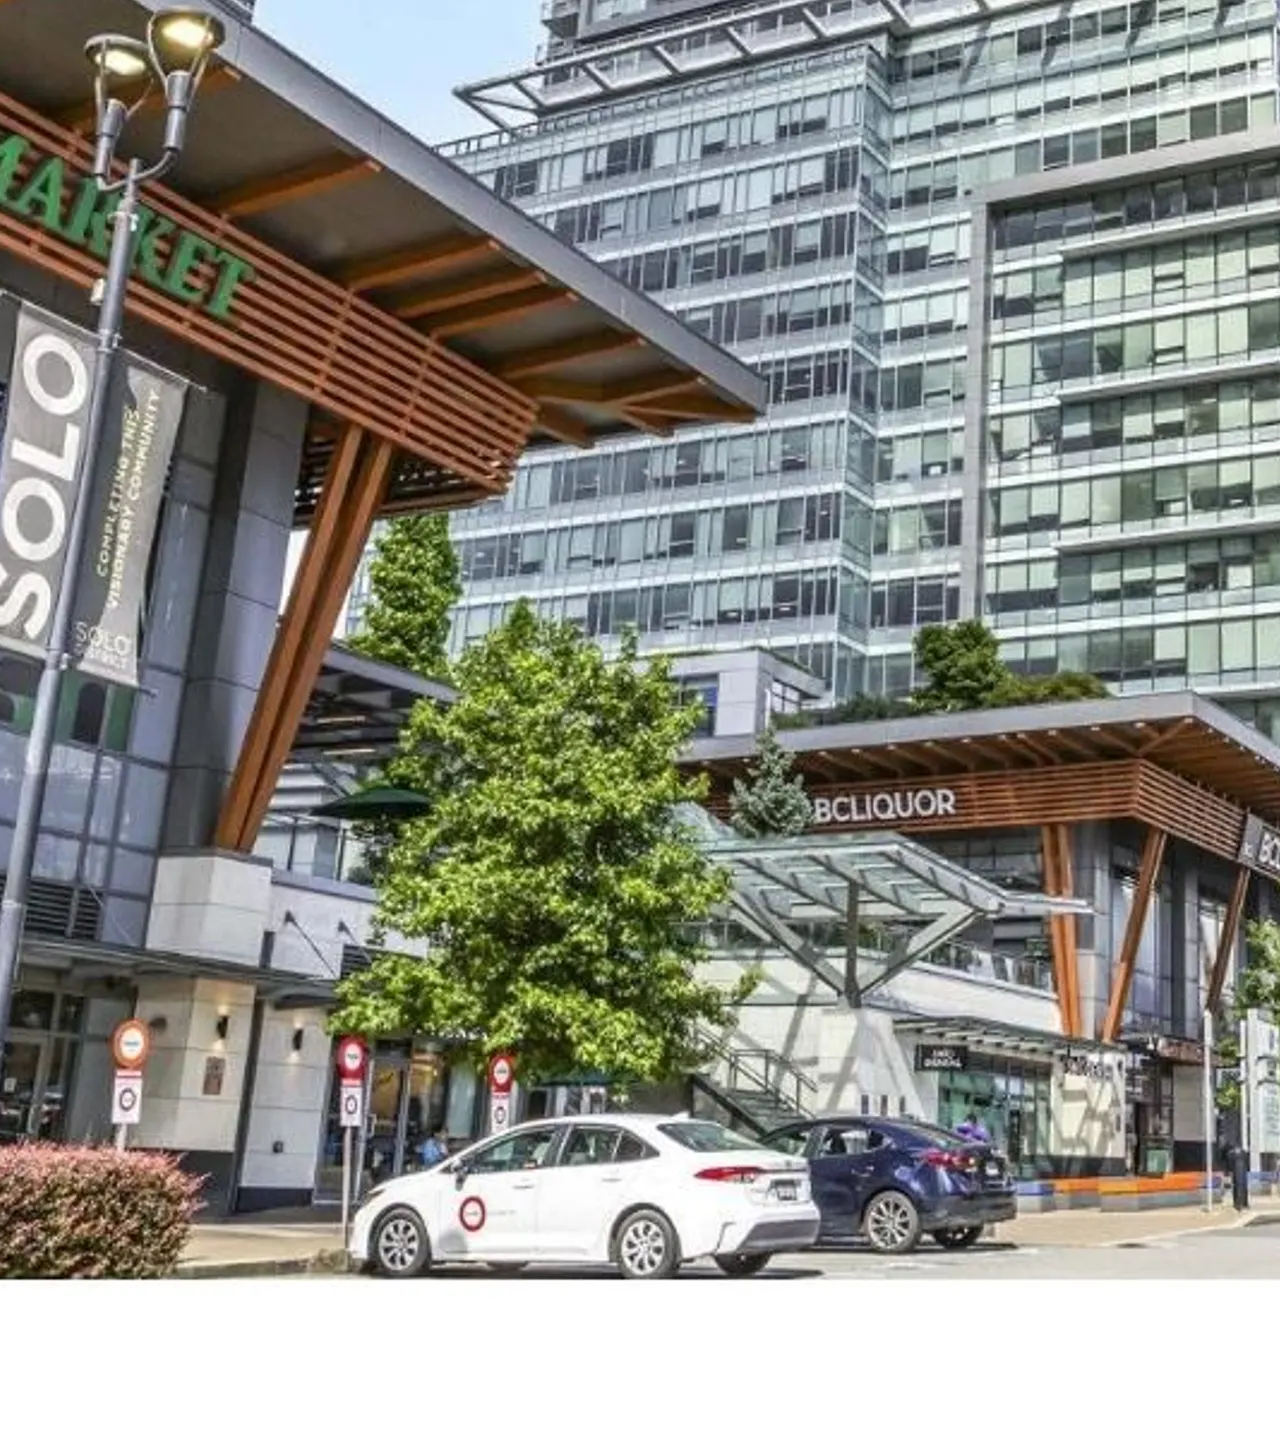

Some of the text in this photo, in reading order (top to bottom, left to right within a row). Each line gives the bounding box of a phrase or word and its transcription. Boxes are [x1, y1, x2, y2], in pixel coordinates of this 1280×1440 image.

[97, 405, 139, 577] COMPLETING THIS
[106, 388, 160, 609] VISIONARY COMMUNITY
[814, 789, 956, 823] BCLIQUOR
